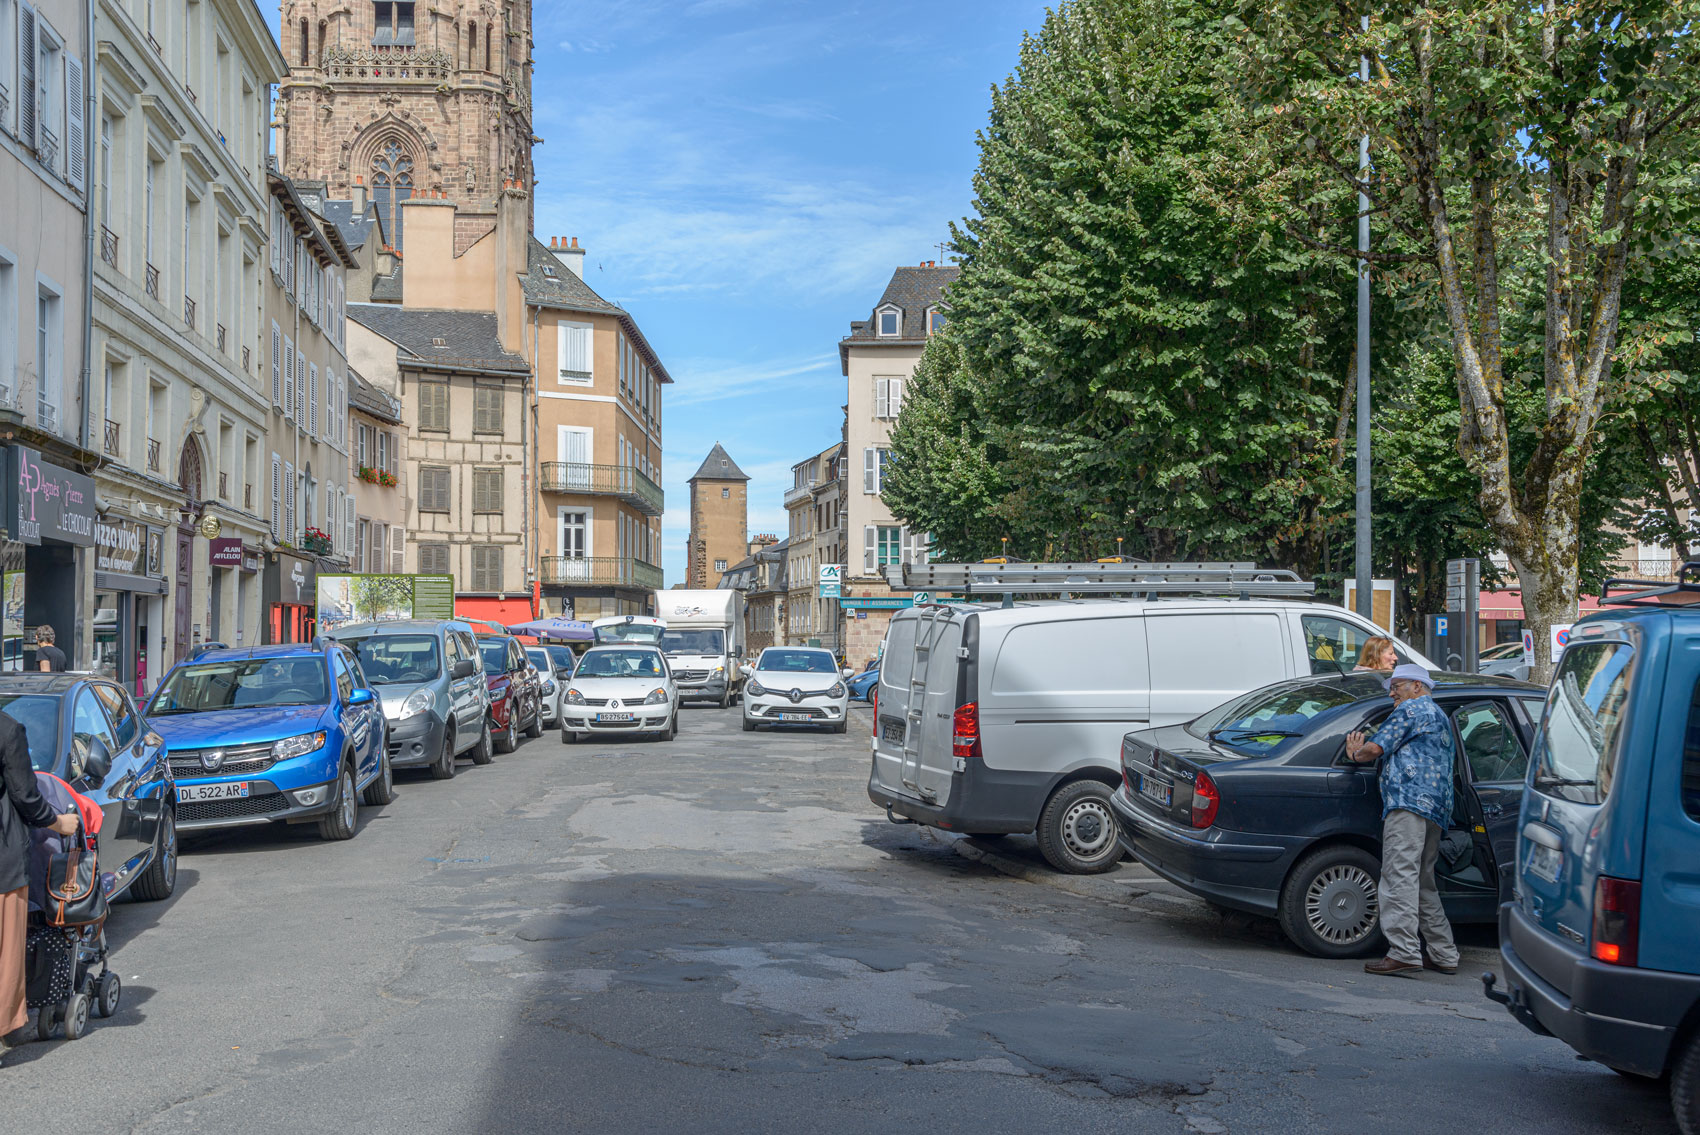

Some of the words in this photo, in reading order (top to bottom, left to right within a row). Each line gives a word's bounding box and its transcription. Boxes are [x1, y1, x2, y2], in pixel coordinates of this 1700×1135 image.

[41, 473, 60, 502] Agnès
[65, 480, 84, 508] Pierre
[18, 520, 41, 539] CHOCOLAT
[68, 512, 92, 537] CHOCOLAT
[1437, 618, 1448, 635] P
[181, 784, 240, 801] DL-522-AR
